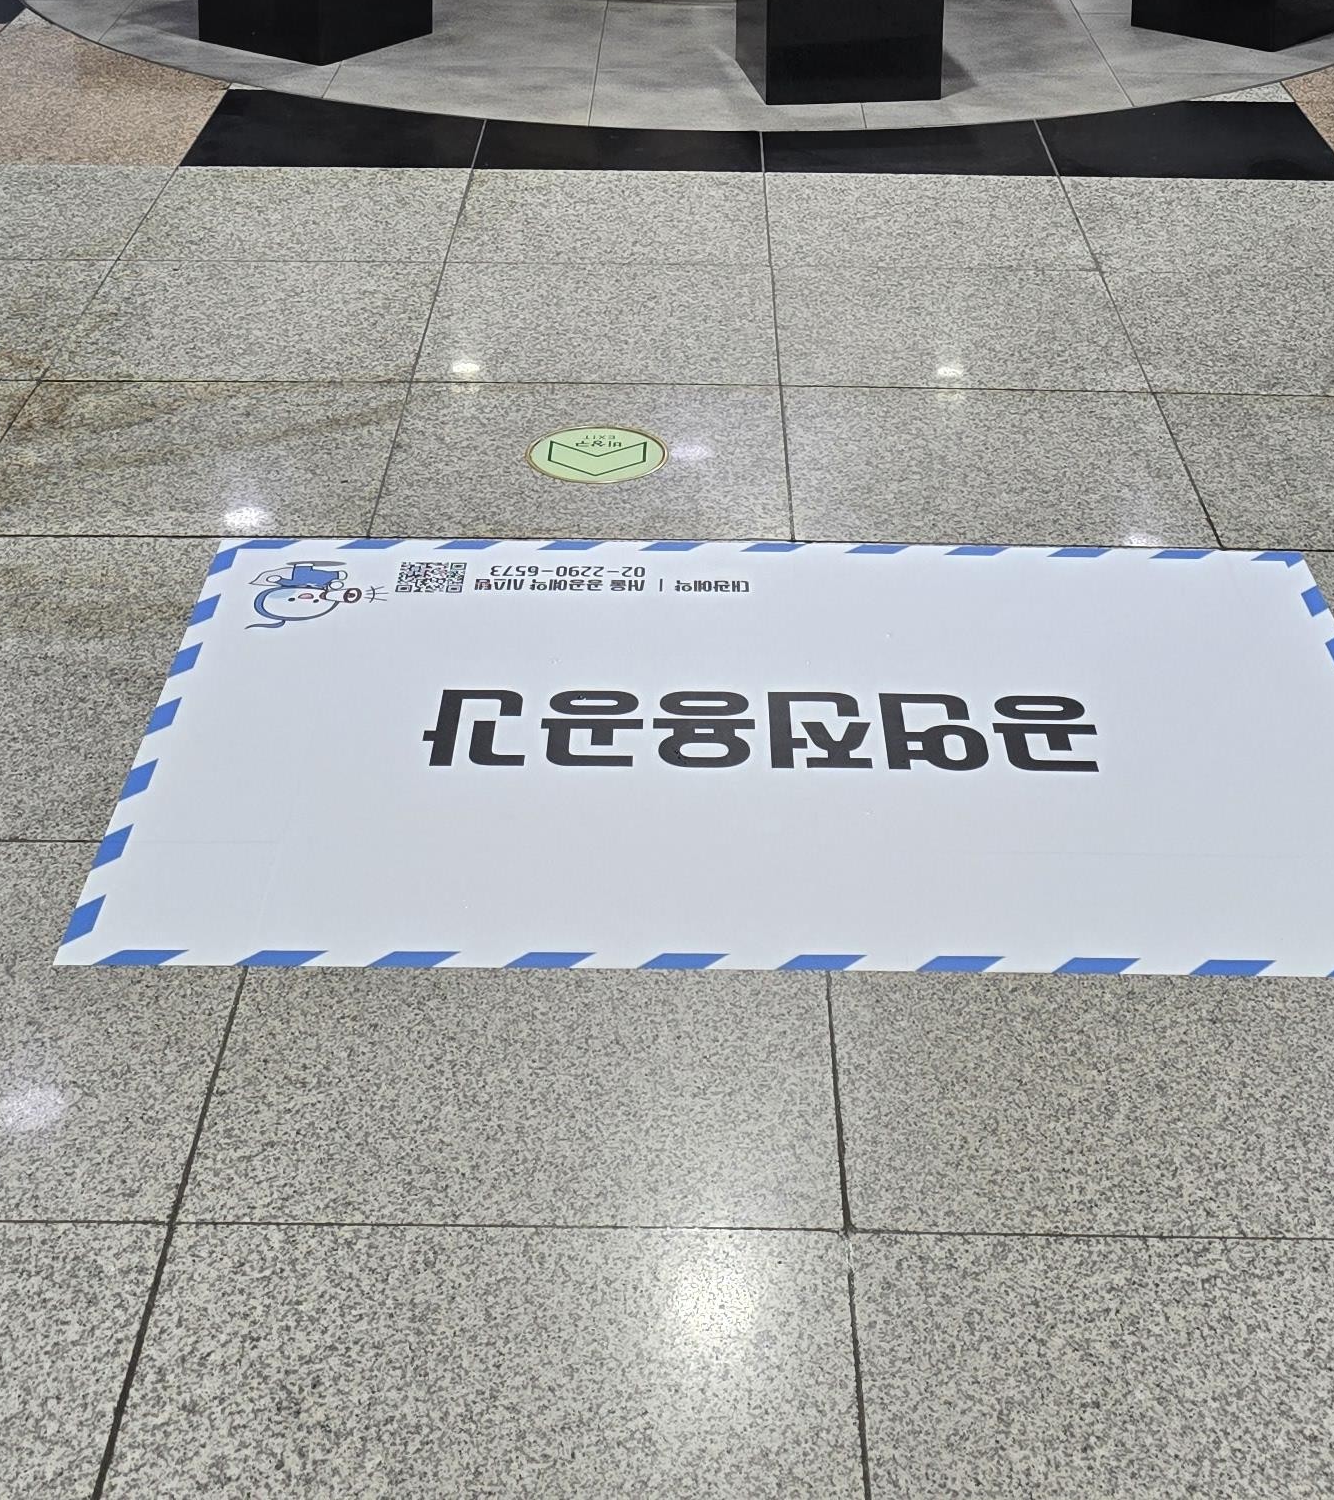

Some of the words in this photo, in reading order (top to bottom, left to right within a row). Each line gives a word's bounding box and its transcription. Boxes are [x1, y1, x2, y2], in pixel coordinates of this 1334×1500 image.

[575, 440, 622, 448] 비상구
[489, 565, 647, 579] 02-2290-6573
[473, 577, 526, 592] 시스템
[530, 577, 607, 593] 공공예약
[610, 578, 647, 593] 서울
[674, 579, 751, 594] 대관예약
[422, 688, 1101, 773] 공연전용공간
